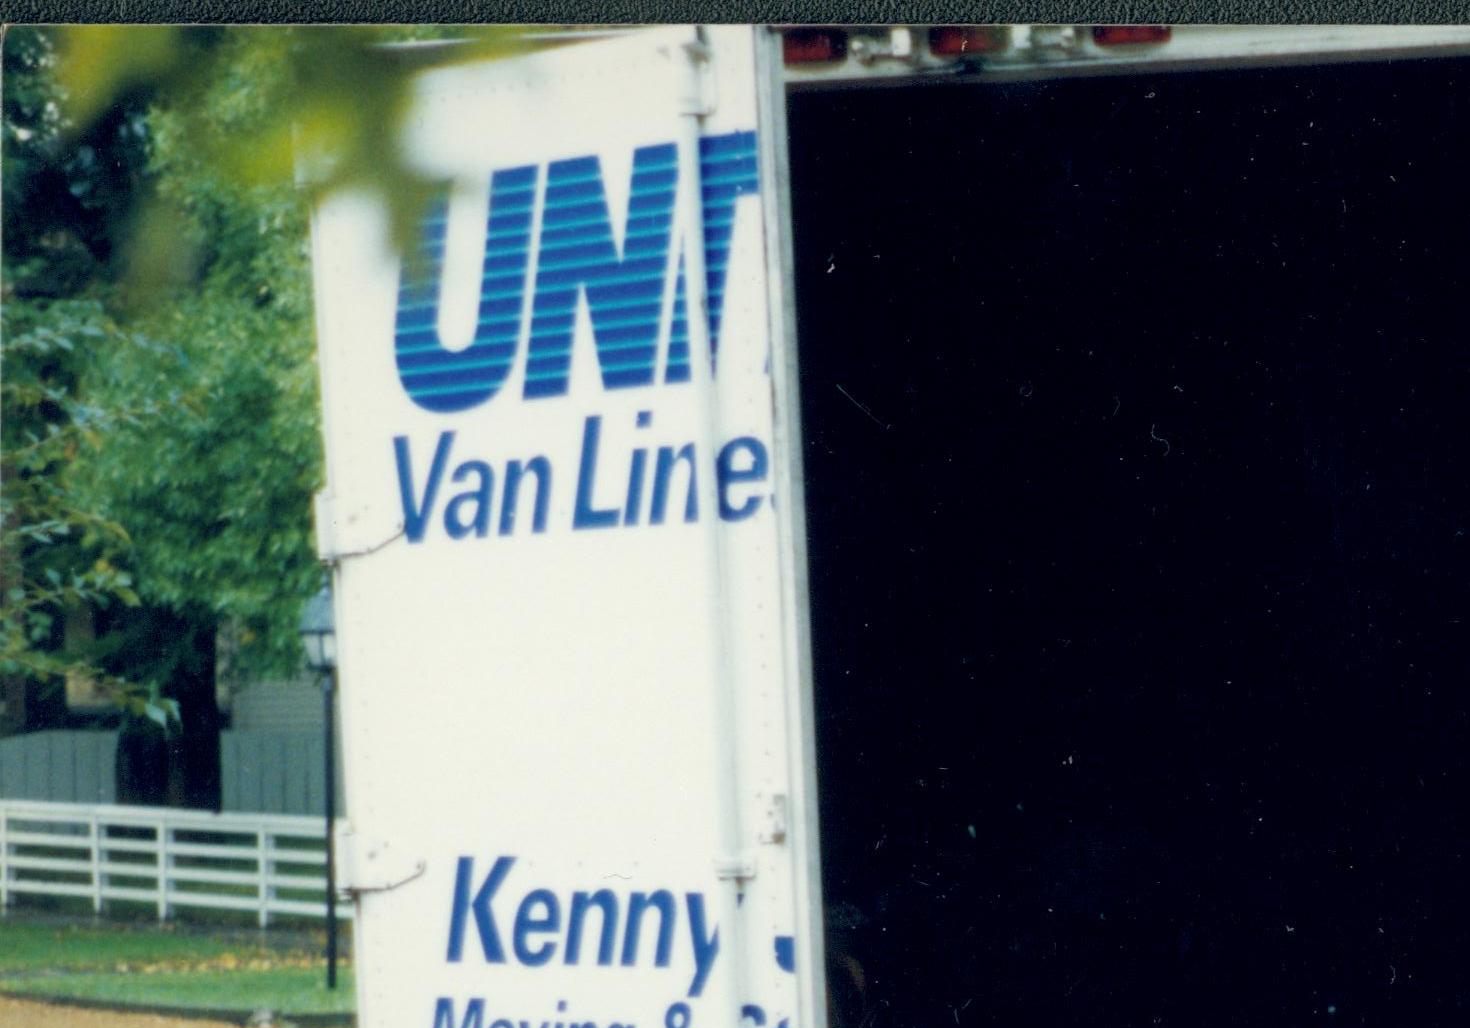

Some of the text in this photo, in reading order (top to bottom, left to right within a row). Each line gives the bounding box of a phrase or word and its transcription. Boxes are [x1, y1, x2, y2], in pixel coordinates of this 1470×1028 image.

[394, 412, 777, 543] Van Line
[446, 857, 720, 997] Kenny
